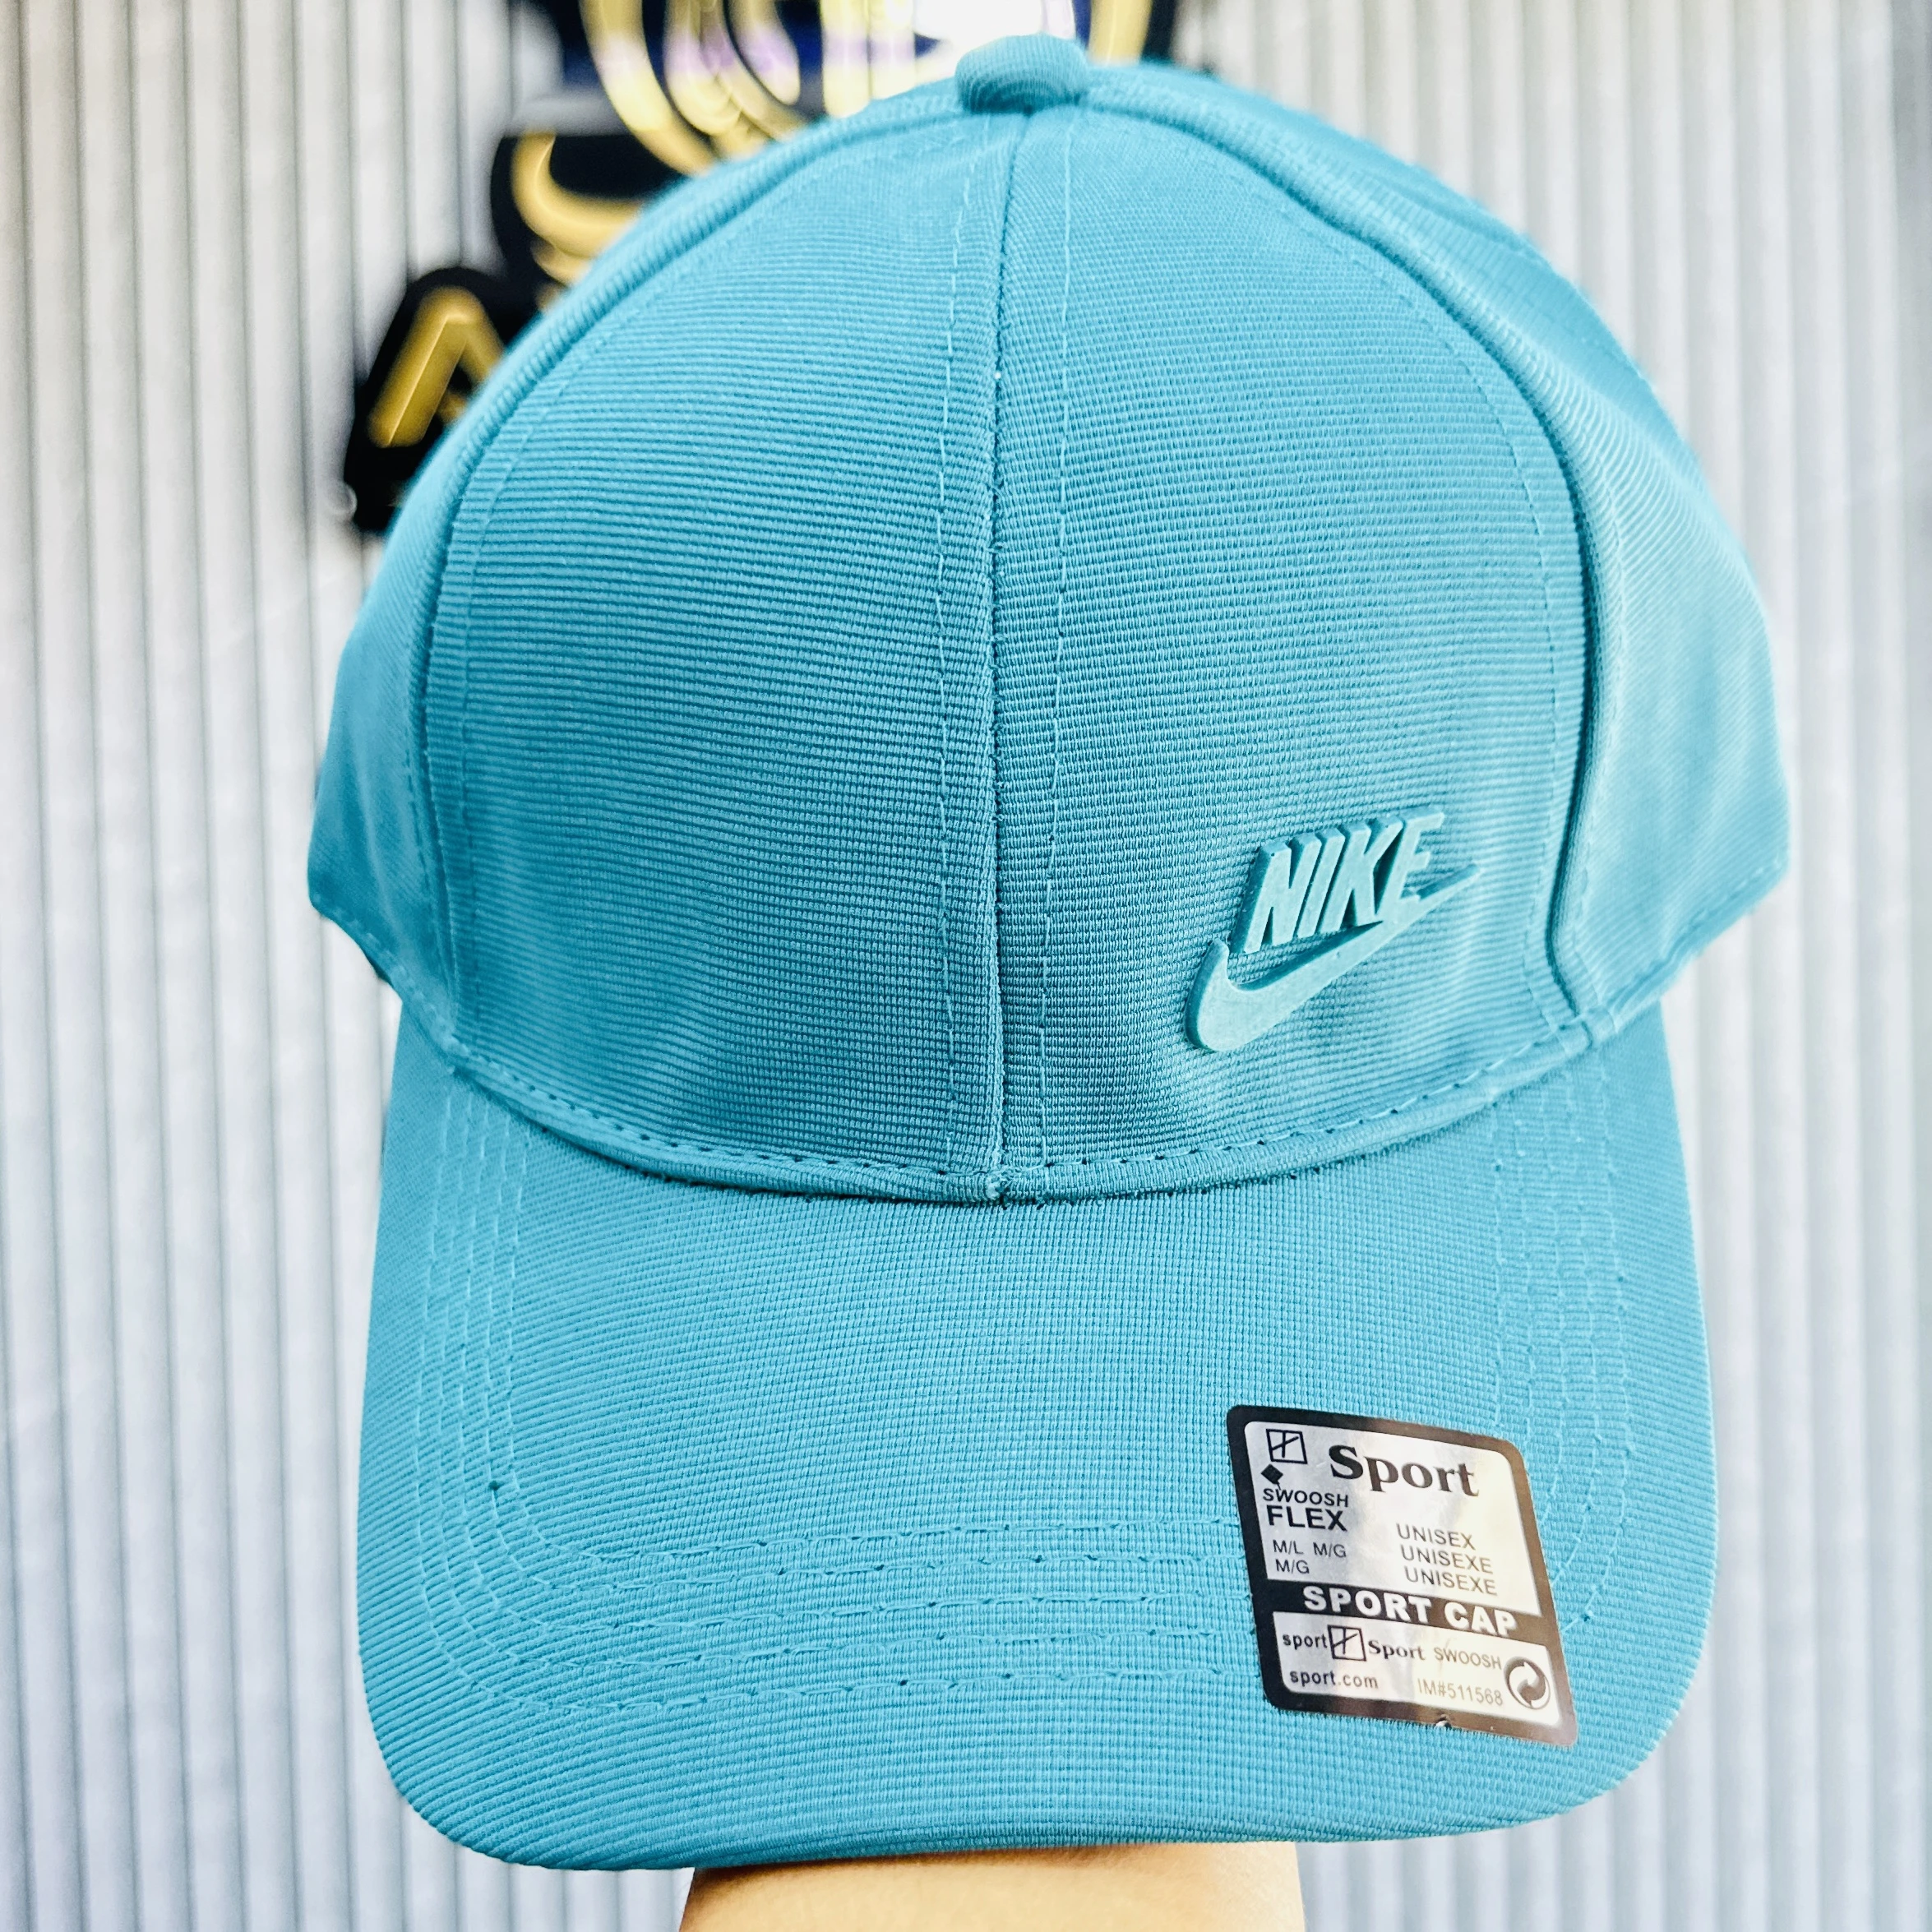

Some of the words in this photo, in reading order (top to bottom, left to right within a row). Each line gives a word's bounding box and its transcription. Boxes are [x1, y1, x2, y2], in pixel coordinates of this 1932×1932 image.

[1236, 807, 1444, 954] NIKE
[1329, 1444, 1479, 1496] Sport
[1263, 1488, 1348, 1507] SWOOSH
[1266, 1504, 1347, 1532] FLEX
[1273, 1539, 1304, 1555] M/L
[1313, 1541, 1347, 1558] M/G
[1396, 1523, 1476, 1551] UNISEX
[1276, 1559, 1310, 1574] M/G
[1400, 1544, 1493, 1574] UNISEXE
[1404, 1565, 1497, 1596] UNISEXE
[1303, 1585, 1431, 1624] SPORT
[1444, 1602, 1518, 1638] CAP
[1283, 1633, 1328, 1650] sport
[1368, 1640, 1426, 1661] Sport
[1434, 1647, 1503, 1670] SWOOSH
[1289, 1670, 1379, 1689] sport.com
[1417, 1678, 1503, 1706] IM#511568
